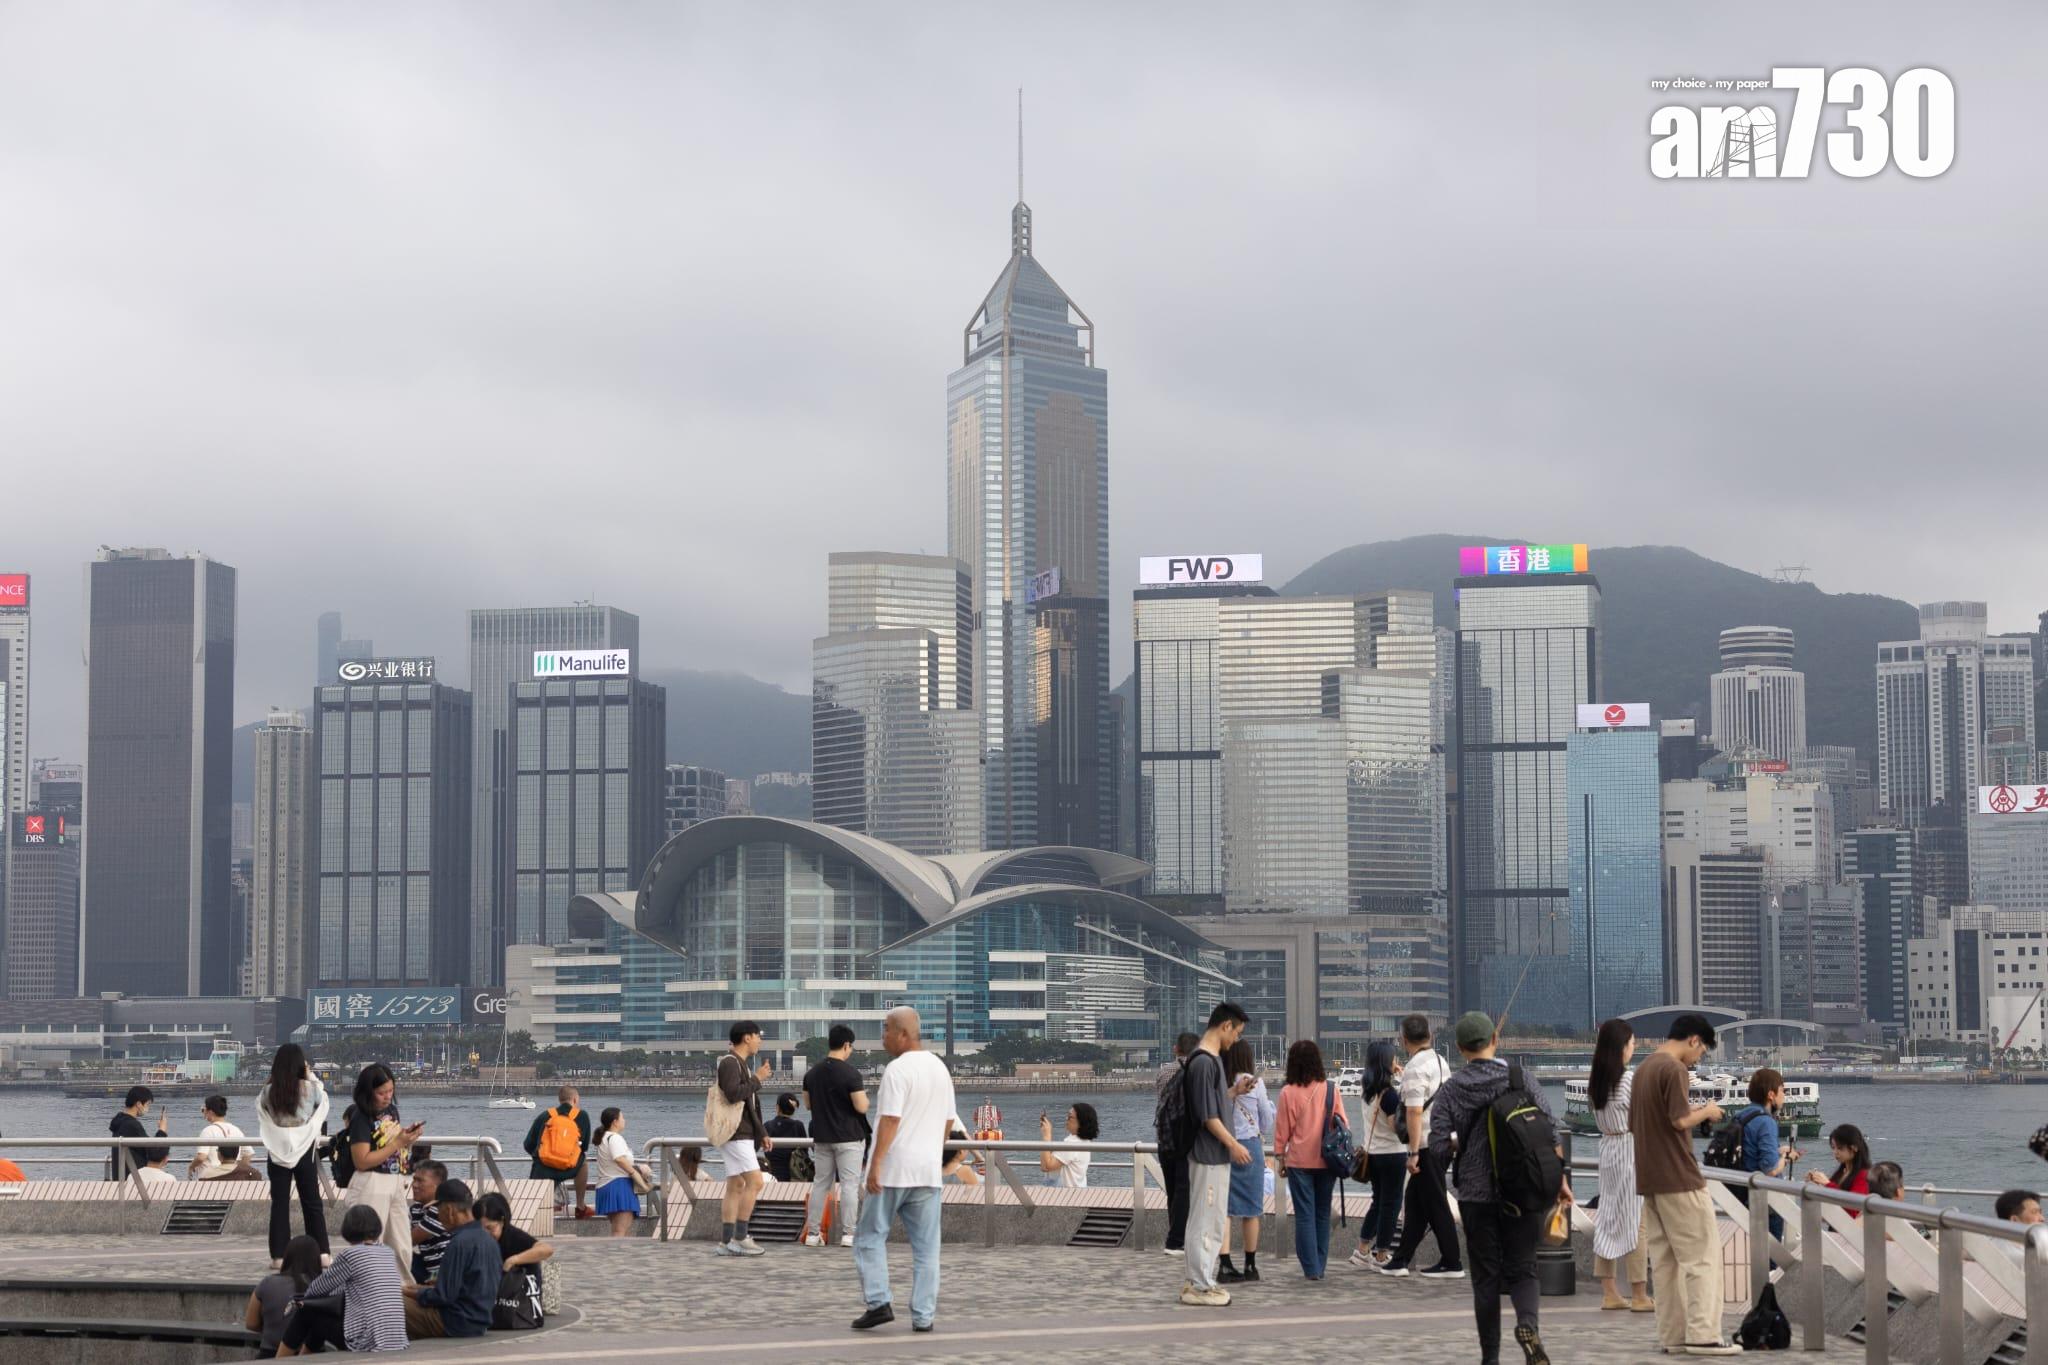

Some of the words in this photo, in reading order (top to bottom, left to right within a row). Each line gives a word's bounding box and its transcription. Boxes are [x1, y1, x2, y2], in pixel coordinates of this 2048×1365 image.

[1168, 557, 1234, 580] FWD
[1498, 548, 1550, 572] 香港
[366, 661, 433, 678] 兴业银行
[559, 654, 626, 672] Manulife
[25, 834, 45, 843] DBS
[314, 994, 373, 1019] 國窖
[376, 994, 455, 1017] 1573
